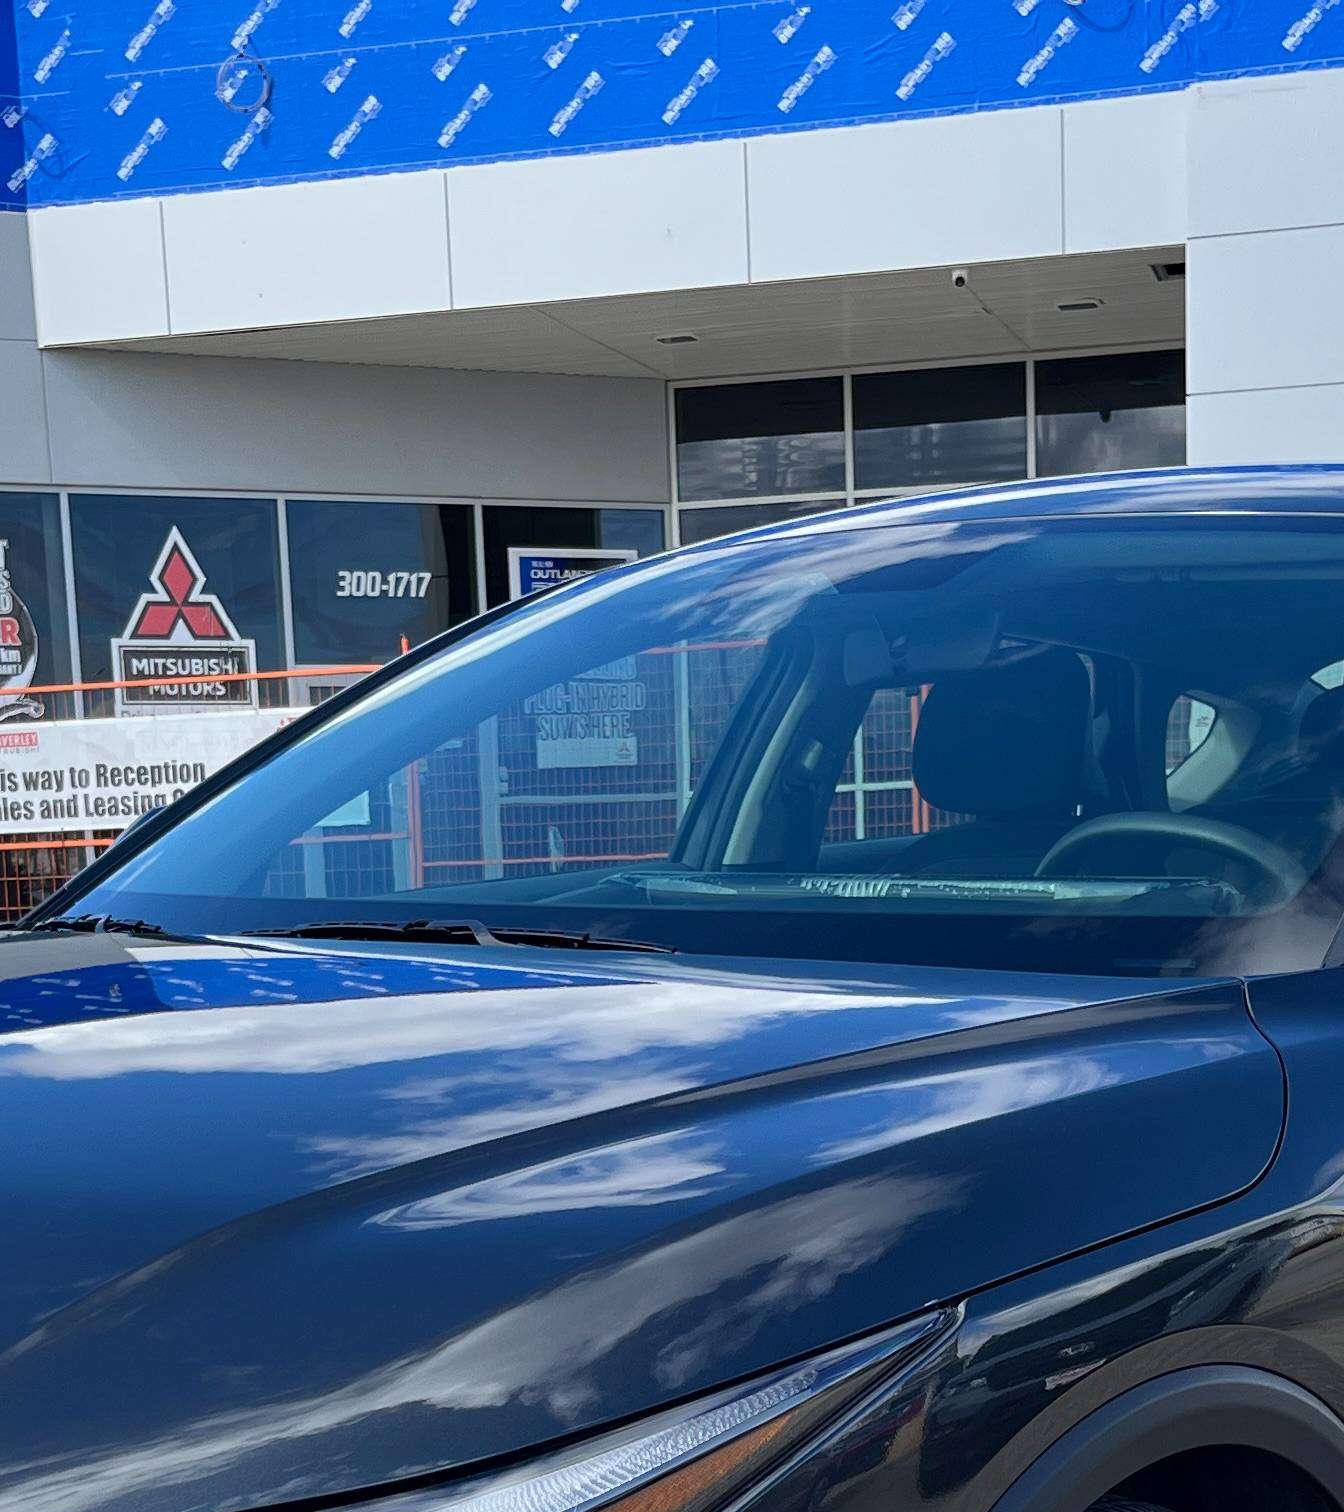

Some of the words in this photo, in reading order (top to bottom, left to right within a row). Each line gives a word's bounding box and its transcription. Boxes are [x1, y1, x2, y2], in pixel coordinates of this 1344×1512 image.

[336, 571, 432, 597] 300-1717
[0, 647, 22, 662] km
[132, 657, 239, 675] MITSUBISHI
[149, 682, 226, 697] MOTORS
[22, 770, 64, 793] way
[69, 767, 90, 789] to
[96, 760, 206, 788] Reception
[40, 794, 80, 819] and
